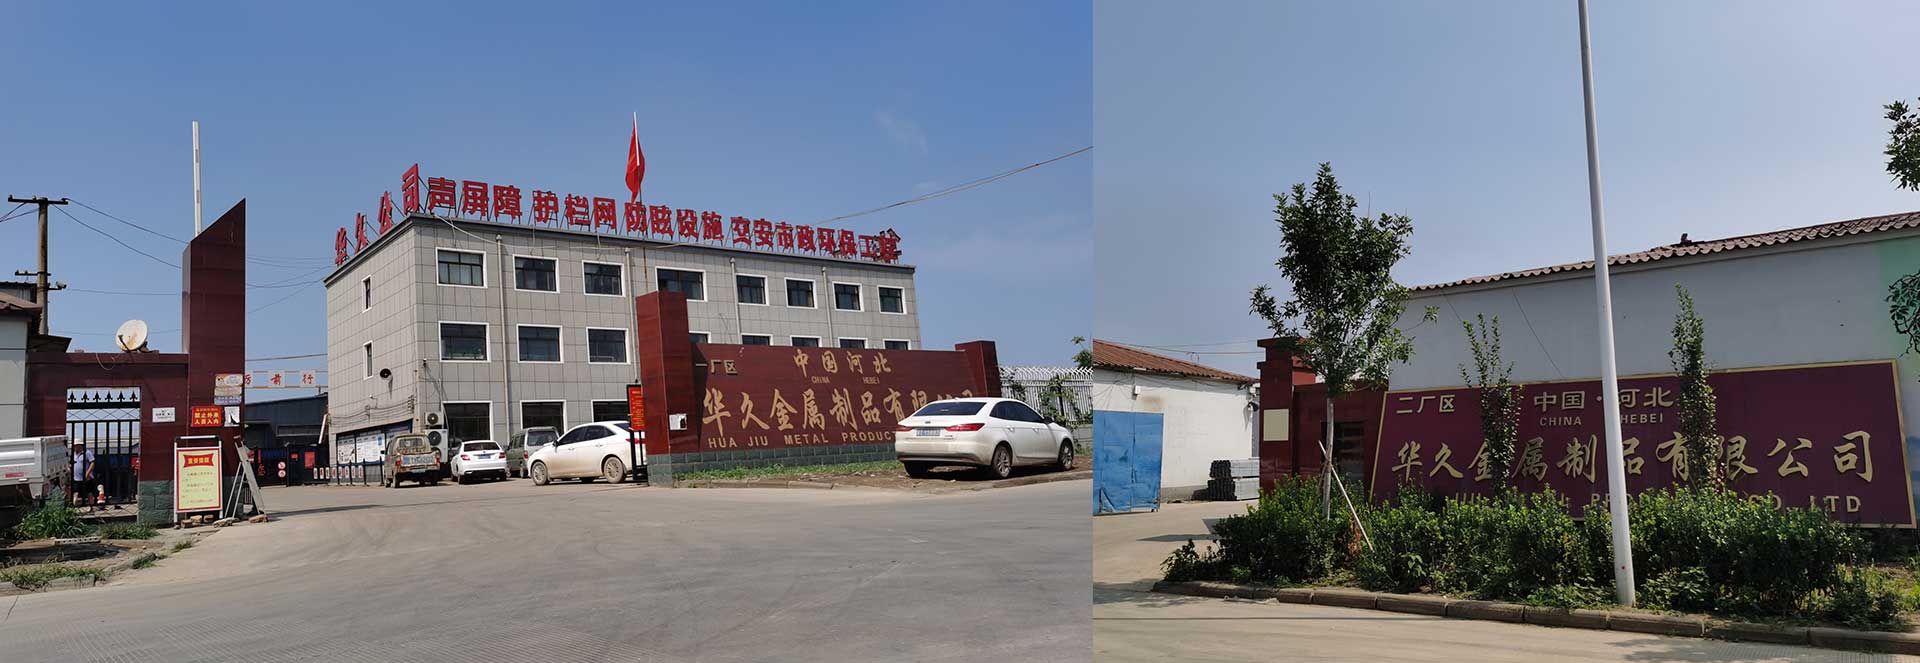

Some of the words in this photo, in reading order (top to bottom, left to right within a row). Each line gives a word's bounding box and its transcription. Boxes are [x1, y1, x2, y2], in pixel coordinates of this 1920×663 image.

[427, 177, 522, 220] 声屏障
[532, 190, 618, 232] 护栏网
[793, 348, 892, 378] 中国河北
[811, 375, 830, 384] CHINA
[863, 377, 880, 385] HEBEI
[702, 387, 973, 438] 华久金属制品有限
[1396, 394, 1456, 414] 二厂区
[1539, 416, 1582, 427] CHINA
[1620, 413, 1664, 425] HEBEI
[708, 436, 738, 449] HUA
[748, 435, 769, 447] JIU
[784, 432, 829, 445] METAL
